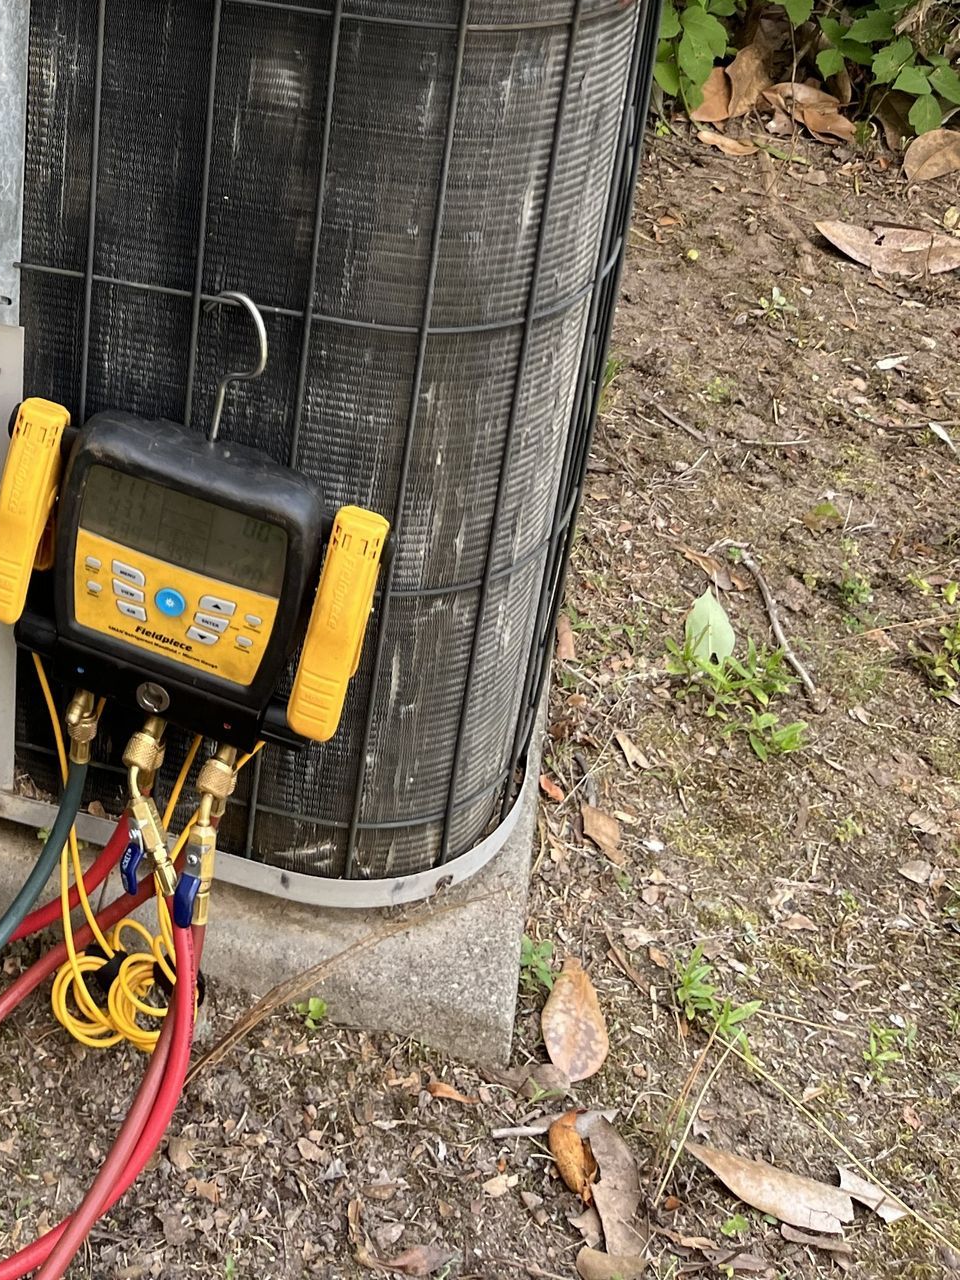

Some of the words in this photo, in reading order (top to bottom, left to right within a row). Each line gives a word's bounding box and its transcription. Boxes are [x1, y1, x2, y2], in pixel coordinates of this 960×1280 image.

[8, 442, 34, 514] Fieldpiece
[119, 570, 136, 579] MENU
[121, 588, 135, 597] VIEW
[327, 554, 355, 631] Fieldpiece
[201, 618, 219, 628] ENTER
[134, 625, 193, 652] Fieldpiece
